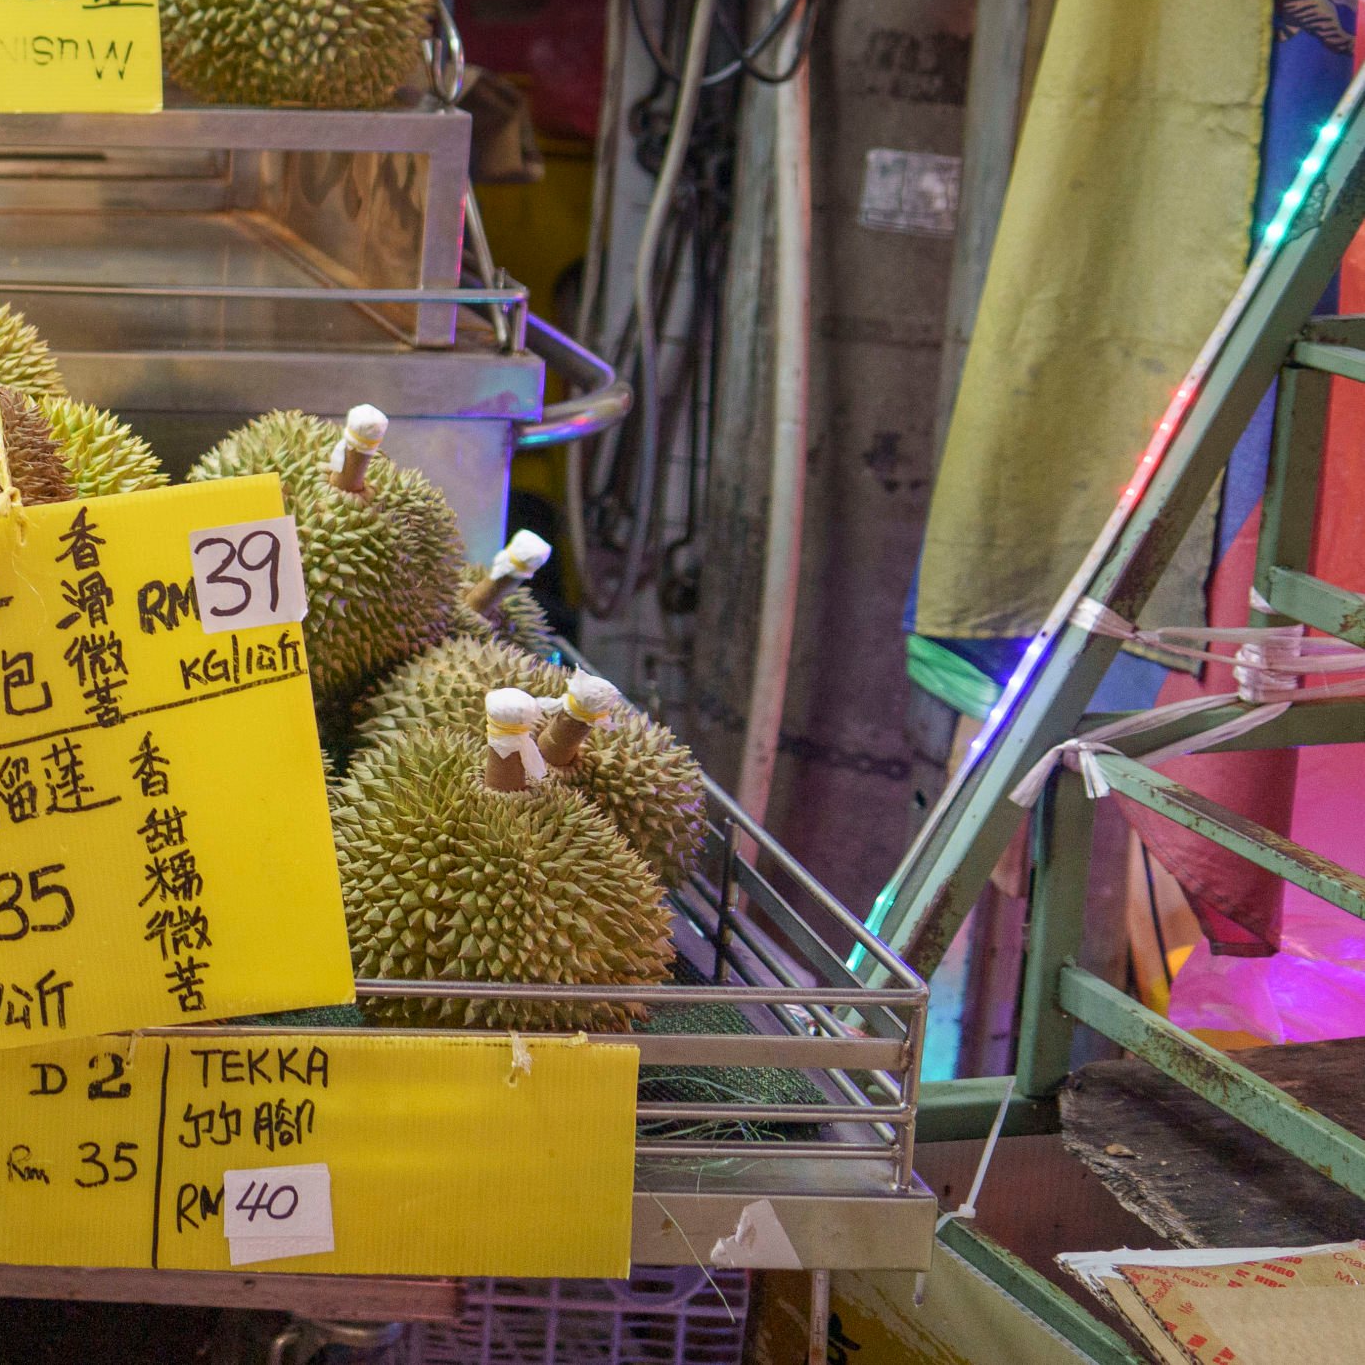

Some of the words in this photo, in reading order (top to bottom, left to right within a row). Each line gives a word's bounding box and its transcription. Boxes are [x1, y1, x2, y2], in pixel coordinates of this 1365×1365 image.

[137, 576, 202, 635] RM
[193, 529, 282, 618] 39
[190, 1045, 329, 1088] TEKKA
[75, 1141, 138, 1187] 35
[235, 1180, 300, 1223] 40
